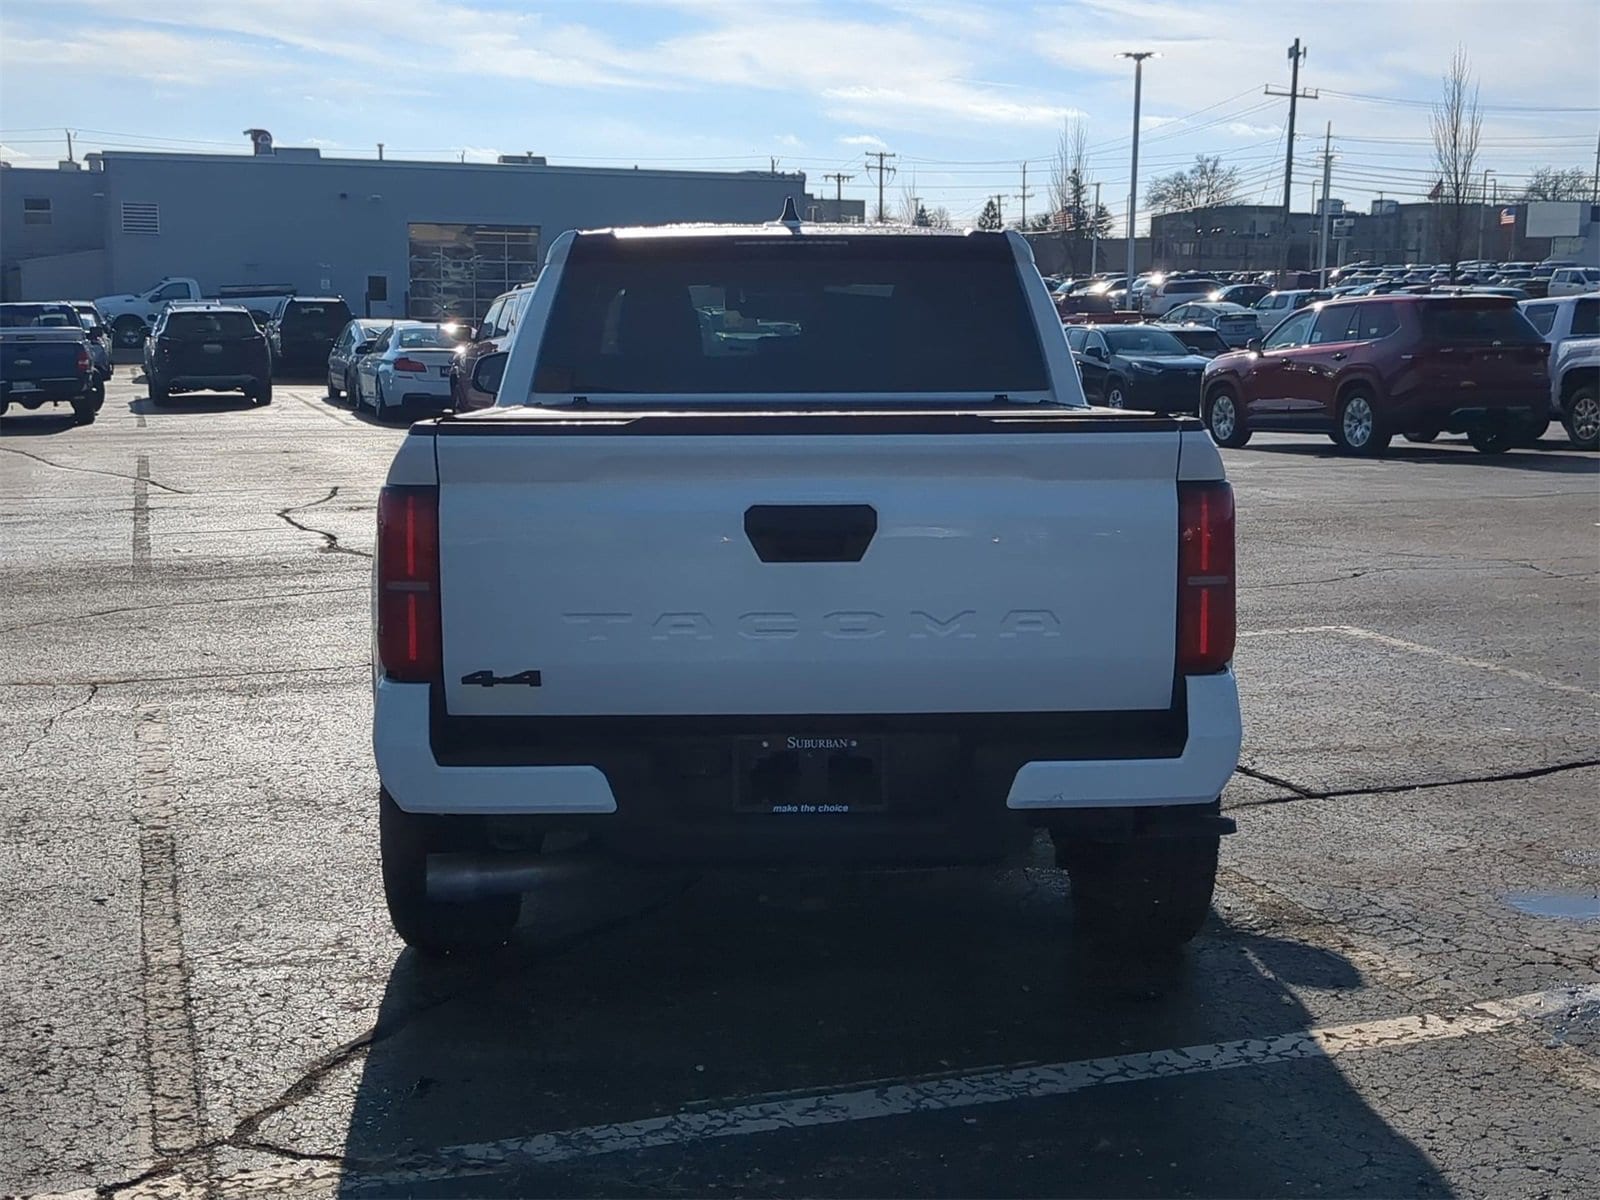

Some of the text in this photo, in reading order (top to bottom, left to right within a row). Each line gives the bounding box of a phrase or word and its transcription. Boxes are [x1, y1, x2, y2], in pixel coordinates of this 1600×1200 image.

[561, 610, 1062, 641] TACOMA
[787, 736, 848, 749] SUBURBAN
[773, 803, 849, 813] make the choice
